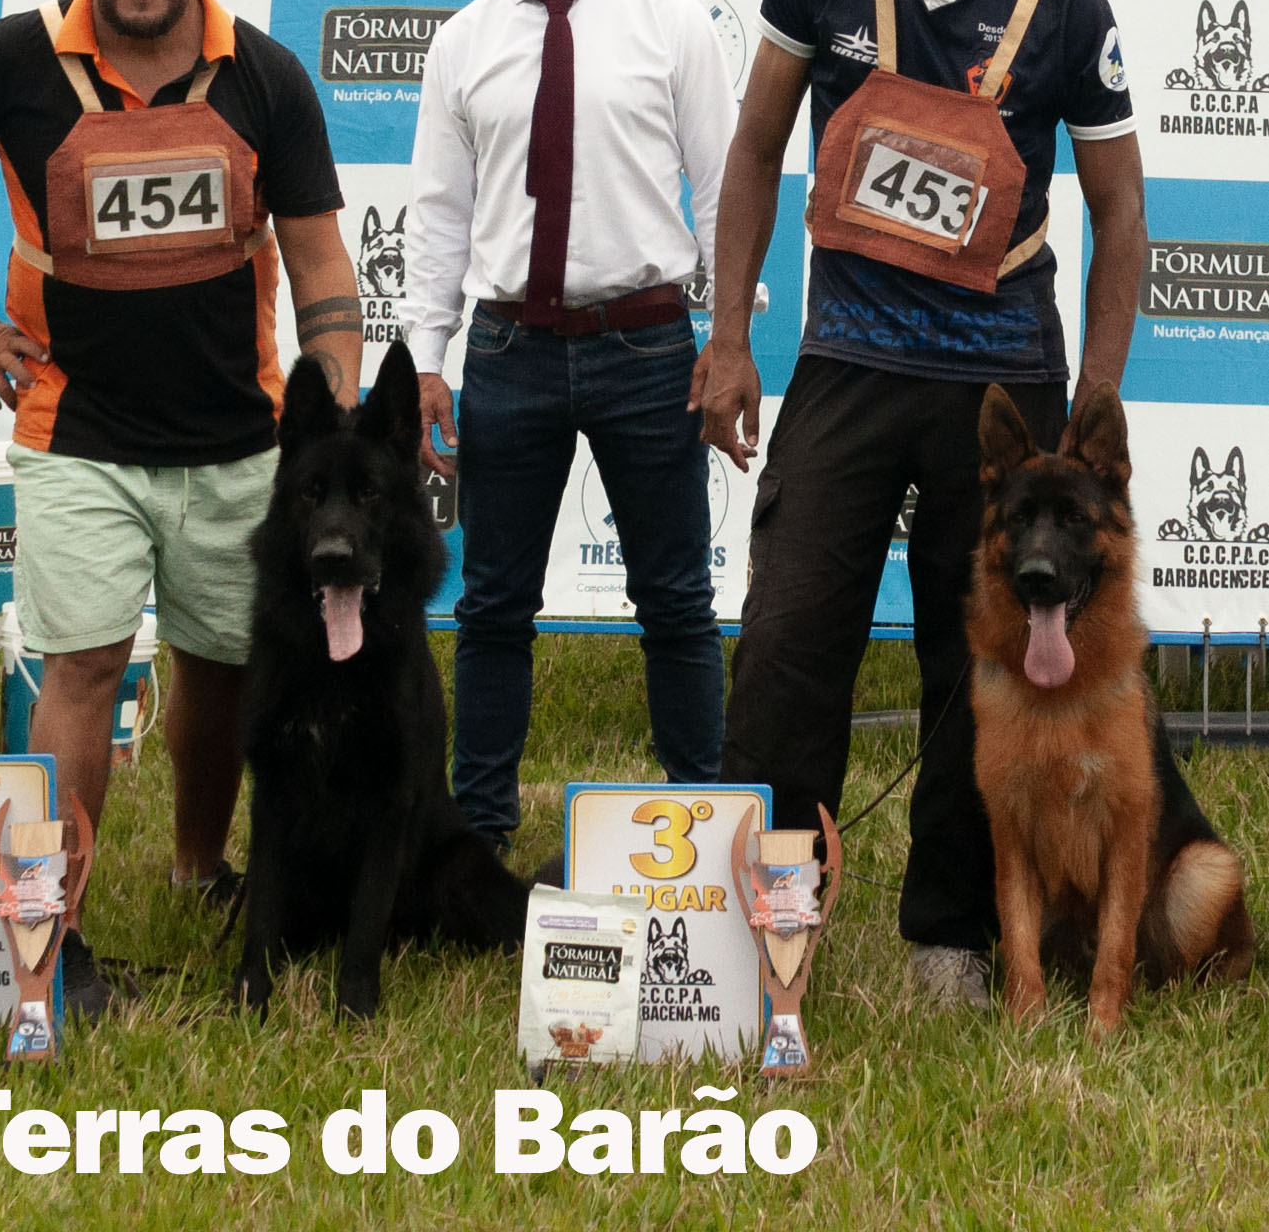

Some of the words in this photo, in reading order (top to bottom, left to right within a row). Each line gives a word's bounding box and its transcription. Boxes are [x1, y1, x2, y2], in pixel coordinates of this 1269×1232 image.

[334, 12, 443, 39] FÓRMU
[330, 49, 427, 74] NATUR
[333, 89, 392, 104] Nutrição
[1190, 93, 1259, 113] C.C.C.P.A
[1160, 115, 1269, 136] BARBACENA-
[97, 173, 219, 232] 454
[870, 159, 979, 235] 453
[1150, 246, 1269, 276] FÓRMUL
[1148, 282, 1269, 312] NATURA
[1153, 324, 1215, 341] Nutrição
[1218, 327, 1269, 343] Avança
[550, 945, 618, 963] FÓRMULA
[548, 962, 616, 980] NATURAL
[641, 1006, 720, 1022] BACENA-MG
